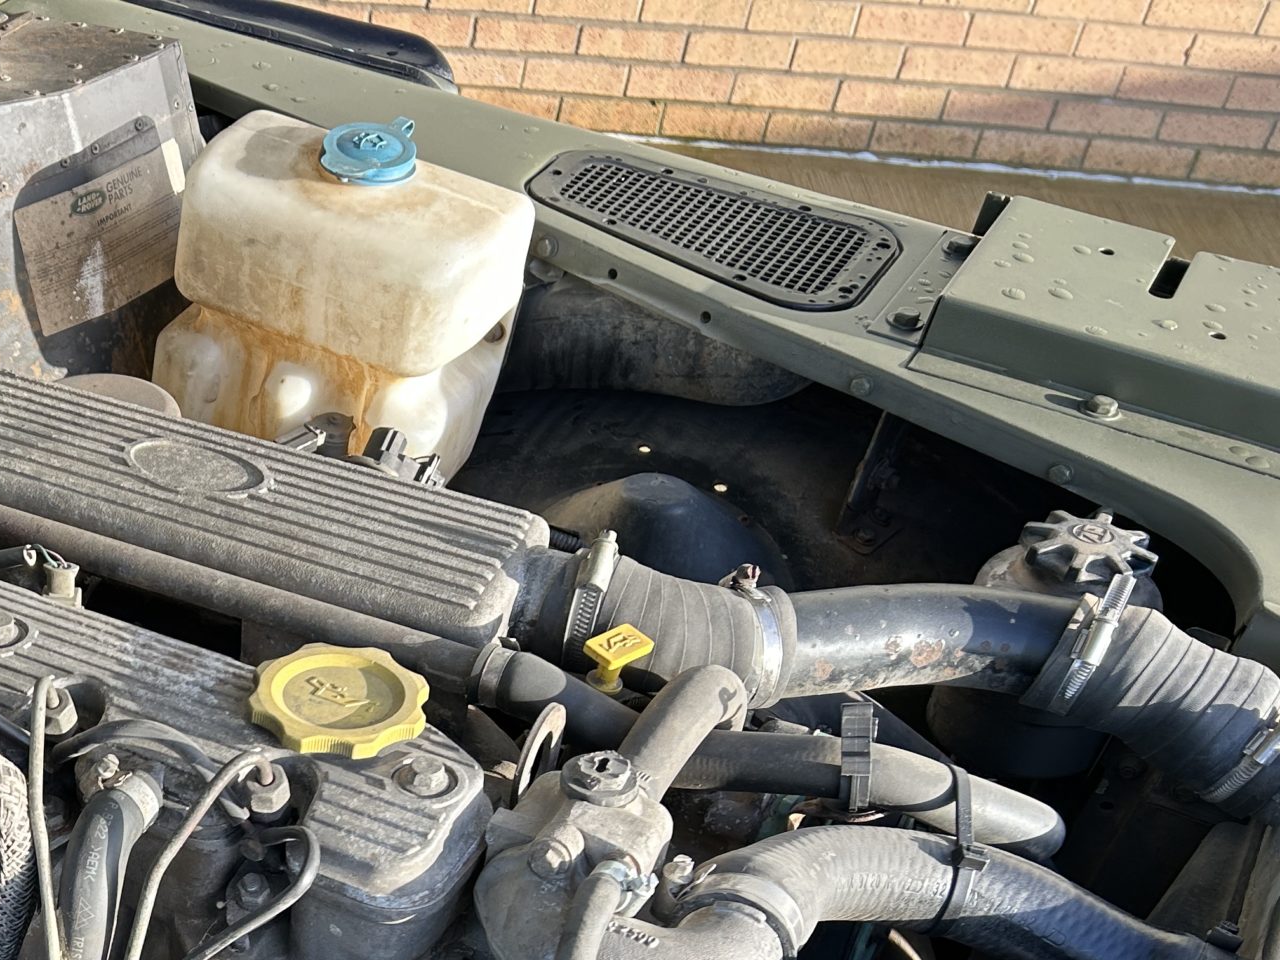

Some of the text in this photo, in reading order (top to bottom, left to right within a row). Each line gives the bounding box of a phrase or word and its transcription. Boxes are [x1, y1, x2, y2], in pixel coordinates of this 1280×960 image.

[106, 168, 143, 193] GENUINE
[108, 185, 134, 205] PARTS
[96, 204, 133, 227] IMPORTANT
